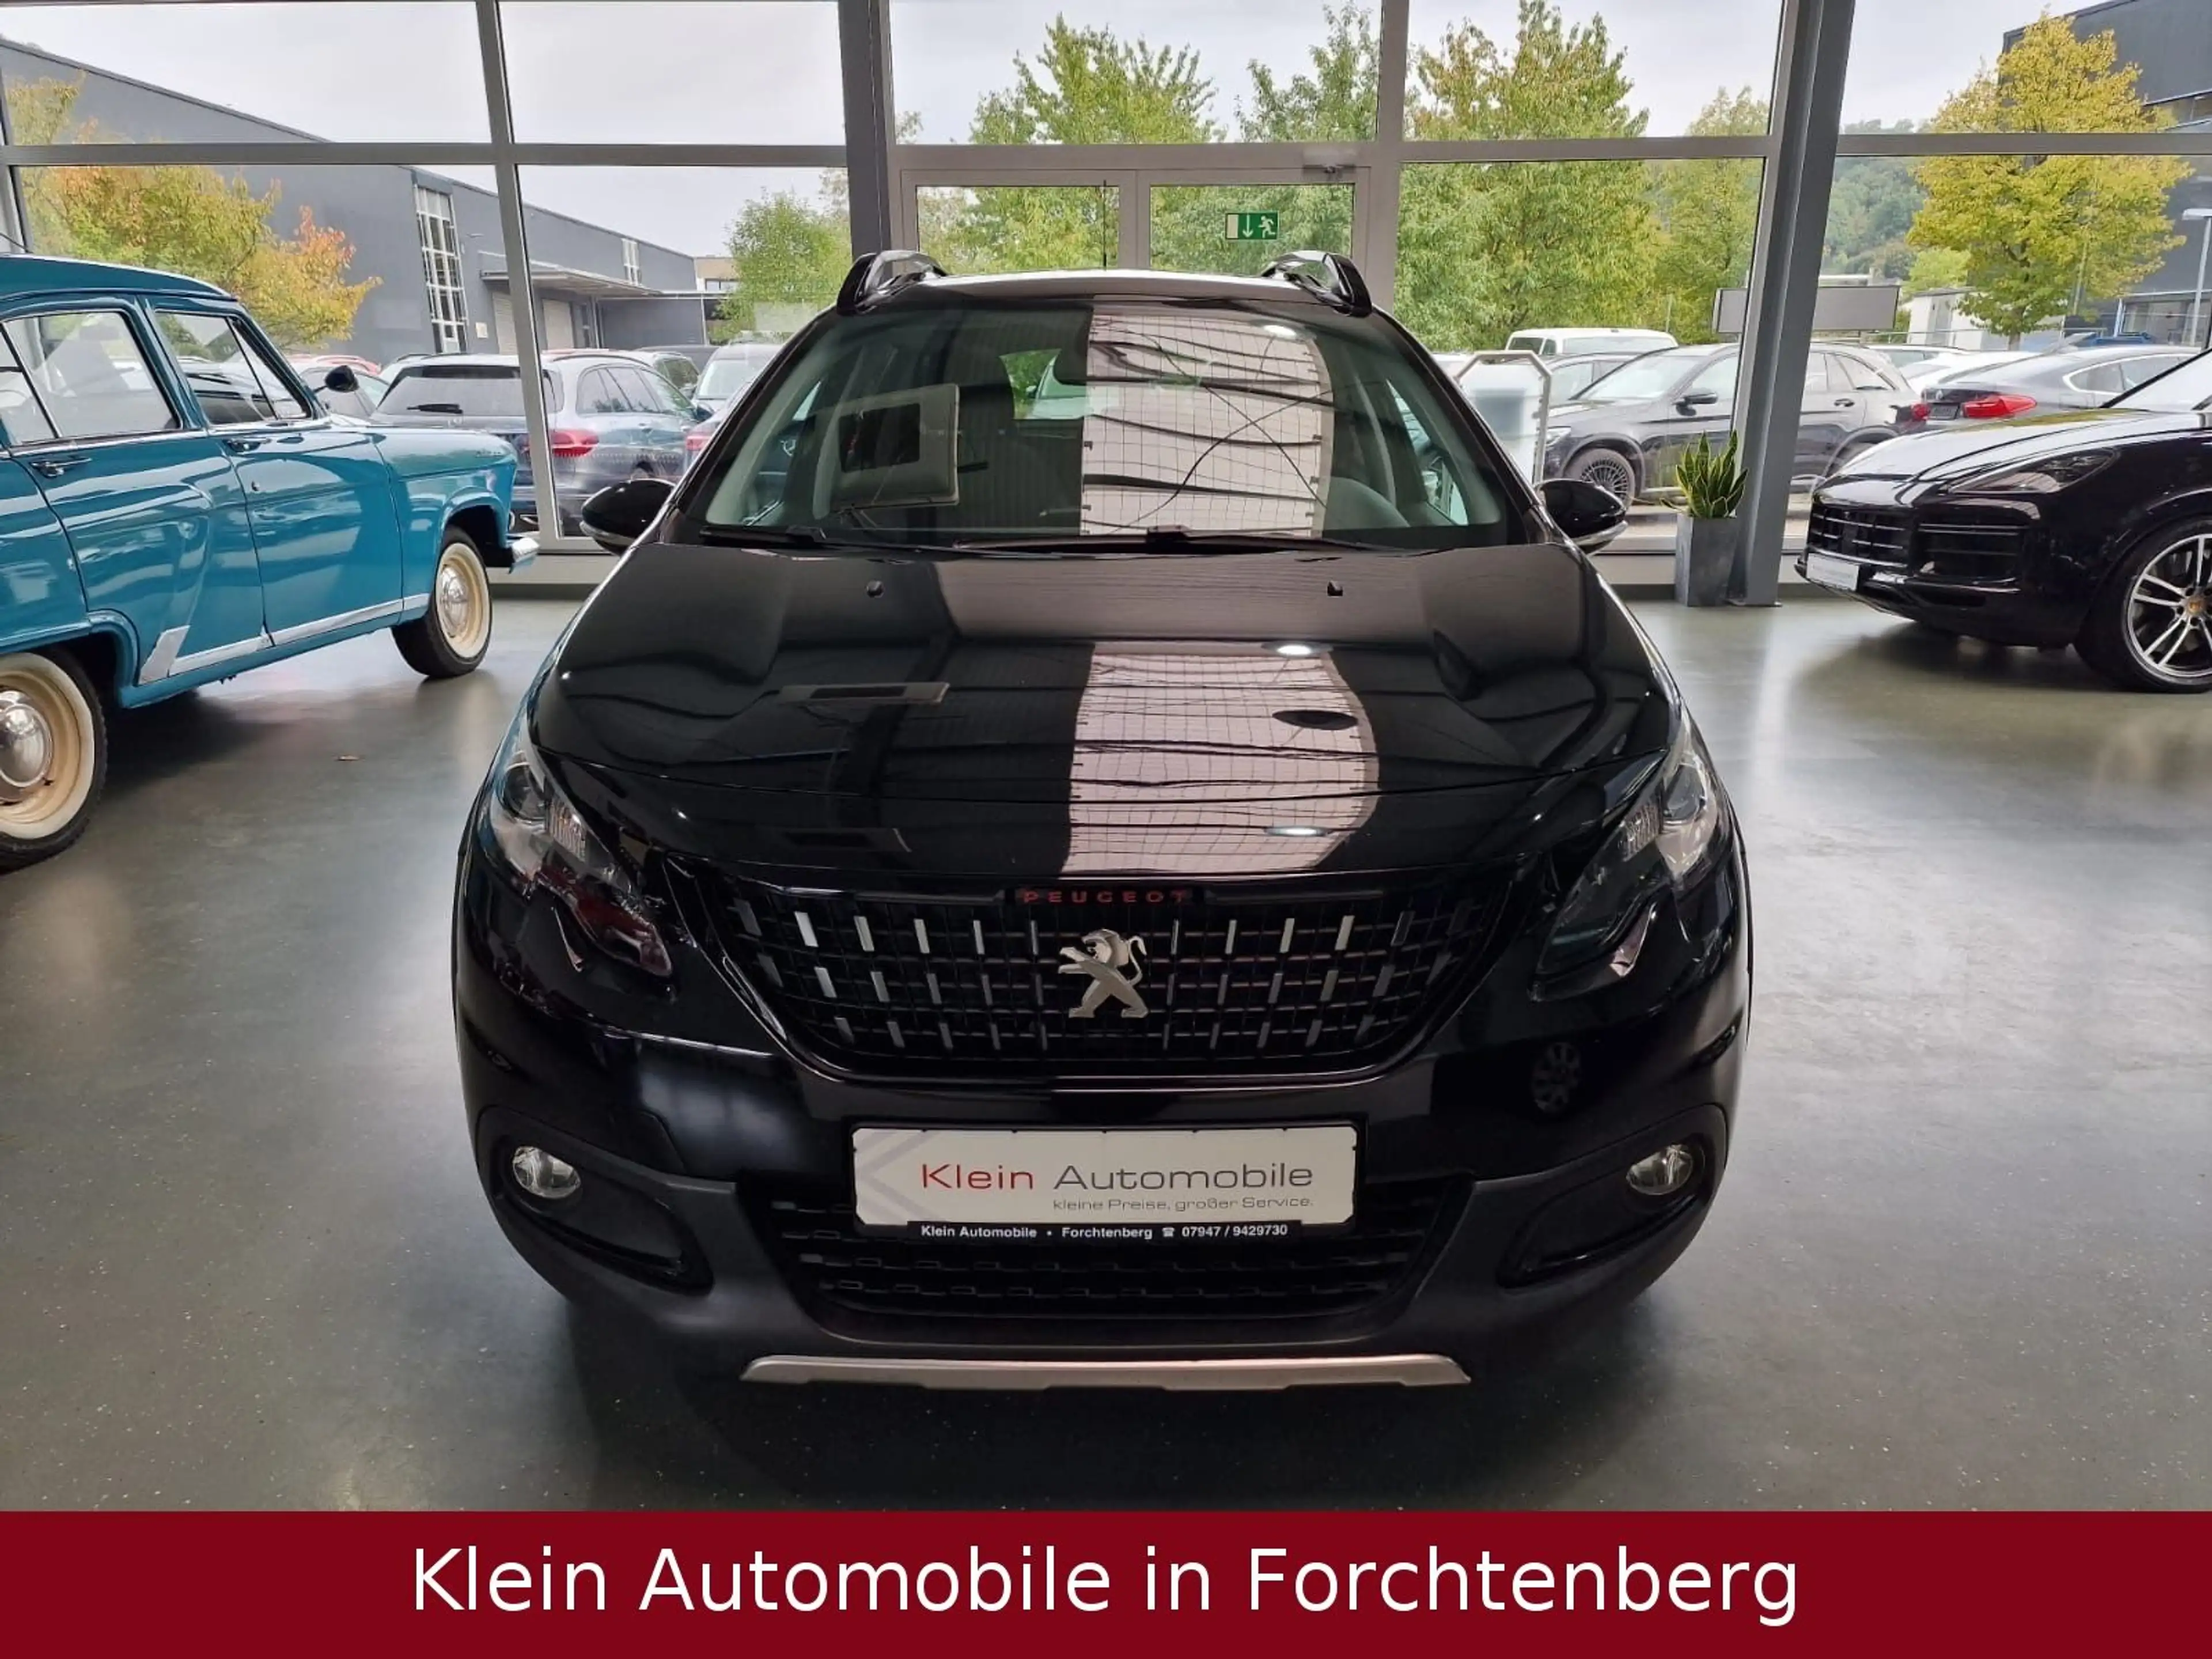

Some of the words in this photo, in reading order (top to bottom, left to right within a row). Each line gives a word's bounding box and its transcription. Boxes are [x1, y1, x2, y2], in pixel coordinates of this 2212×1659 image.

[1022, 891, 1188, 903] PEUGEOT
[922, 1164, 1033, 1190] Klein
[1053, 1162, 1313, 1190] Automobile
[1053, 1198, 1104, 1211] kleine
[1108, 1198, 1171, 1211] Preise,
[1175, 1197, 1238, 1212] großer
[1243, 1196, 1314, 1209] Service.
[922, 1225, 955, 1237] Klein
[960, 1226, 1037, 1237] Automobile
[1062, 1226, 1153, 1240] Forchtenberg
[1181, 1226, 1220, 1237] 07947
[1232, 1224, 1289, 1237] 9429730
